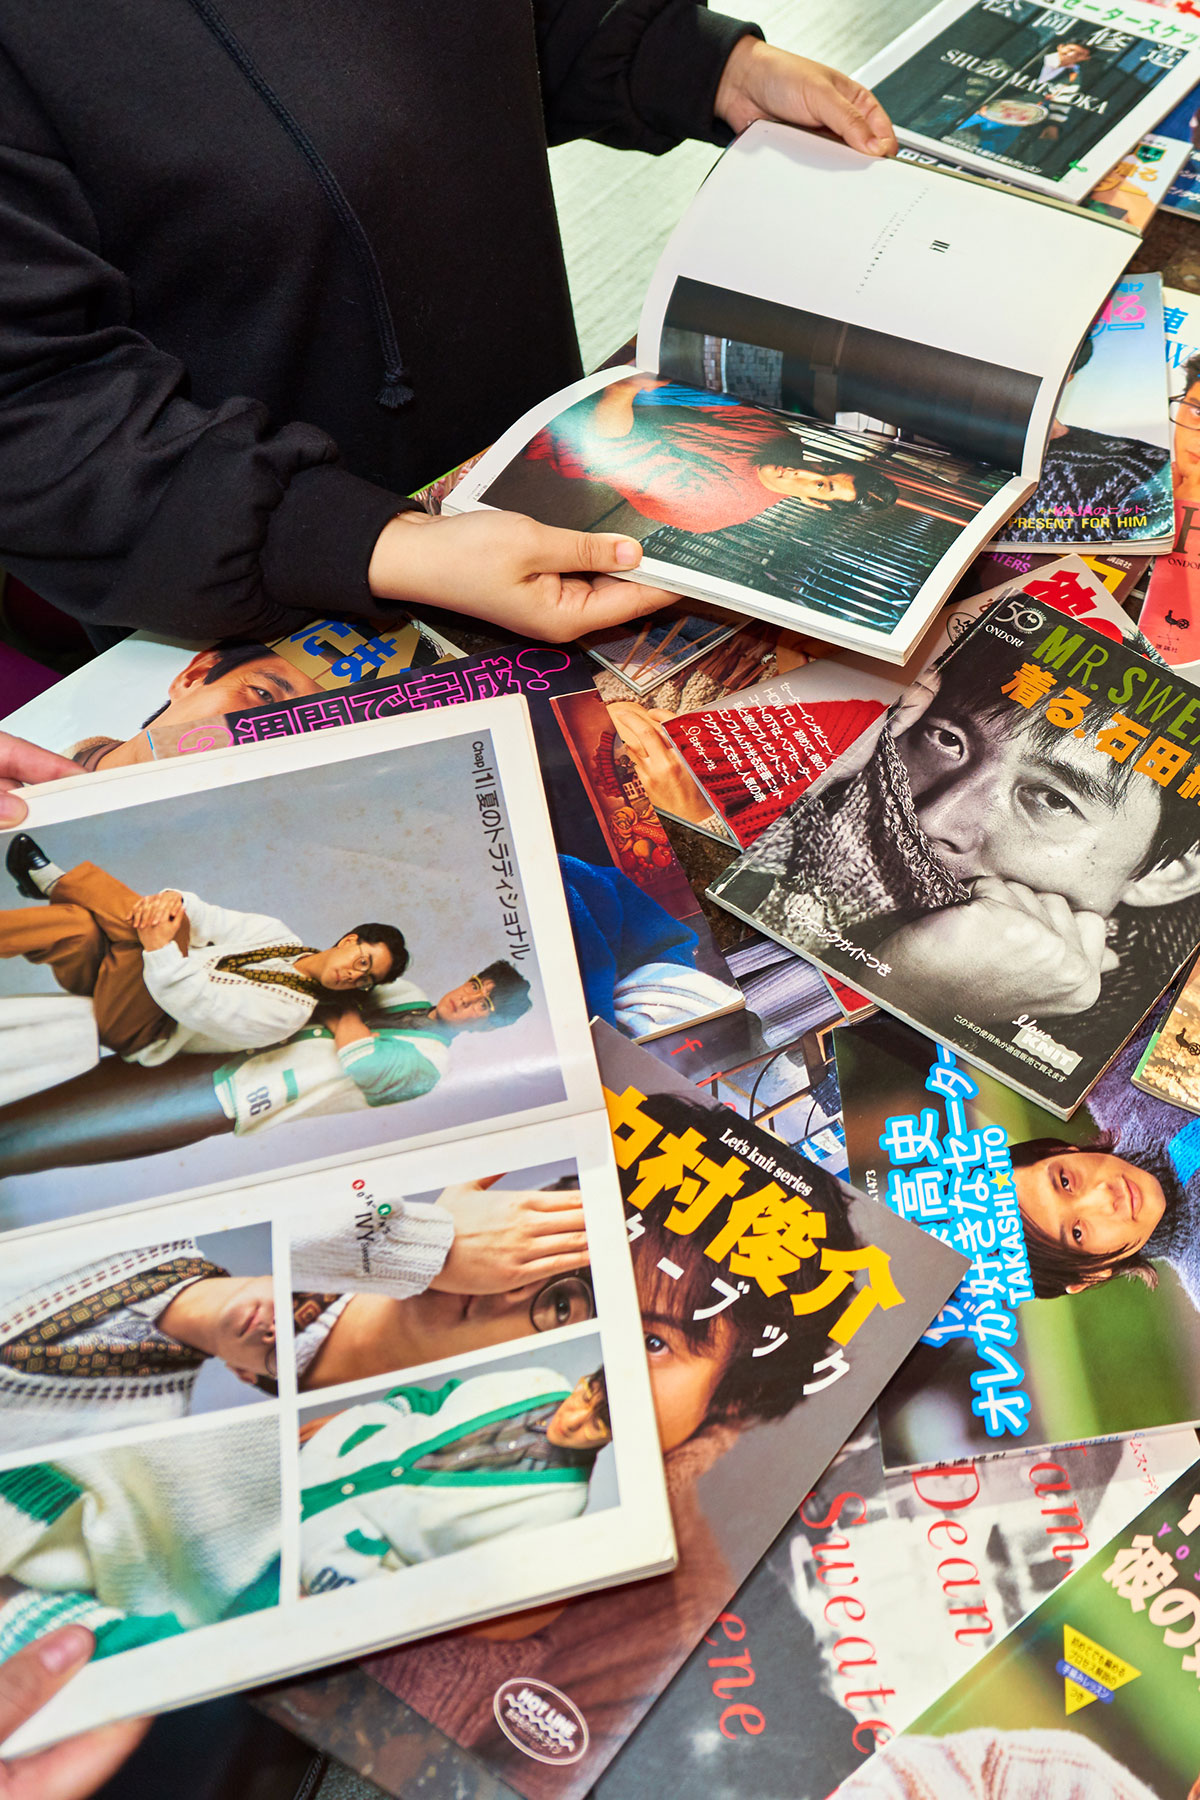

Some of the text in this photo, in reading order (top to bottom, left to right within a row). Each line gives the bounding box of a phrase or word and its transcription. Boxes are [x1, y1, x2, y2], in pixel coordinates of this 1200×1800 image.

[940, 49, 1109, 115] SHUZO MATOKA
[1009, 514, 1148, 530] PRESENT FOR HIM
[984, 622, 1026, 649] ONDORI
[471, 740, 486, 769] Chap
[475, 790, 531, 961] 夏のトラディショナル
[788, 908, 893, 978] テクニックガイドつき
[953, 1012, 1069, 1084] この本の使用糸が通信販売で買えます
[1021, 1032, 1074, 1066] KNIT
[718, 1127, 815, 1199] Let's knit series
[354, 1211, 375, 1243] IVY
[982, 1127, 1033, 1306] TAKASHI ITO
[912, 1463, 994, 1649] Dean
[514, 1685, 552, 1719] HOT
[541, 1704, 580, 1741] LINE
